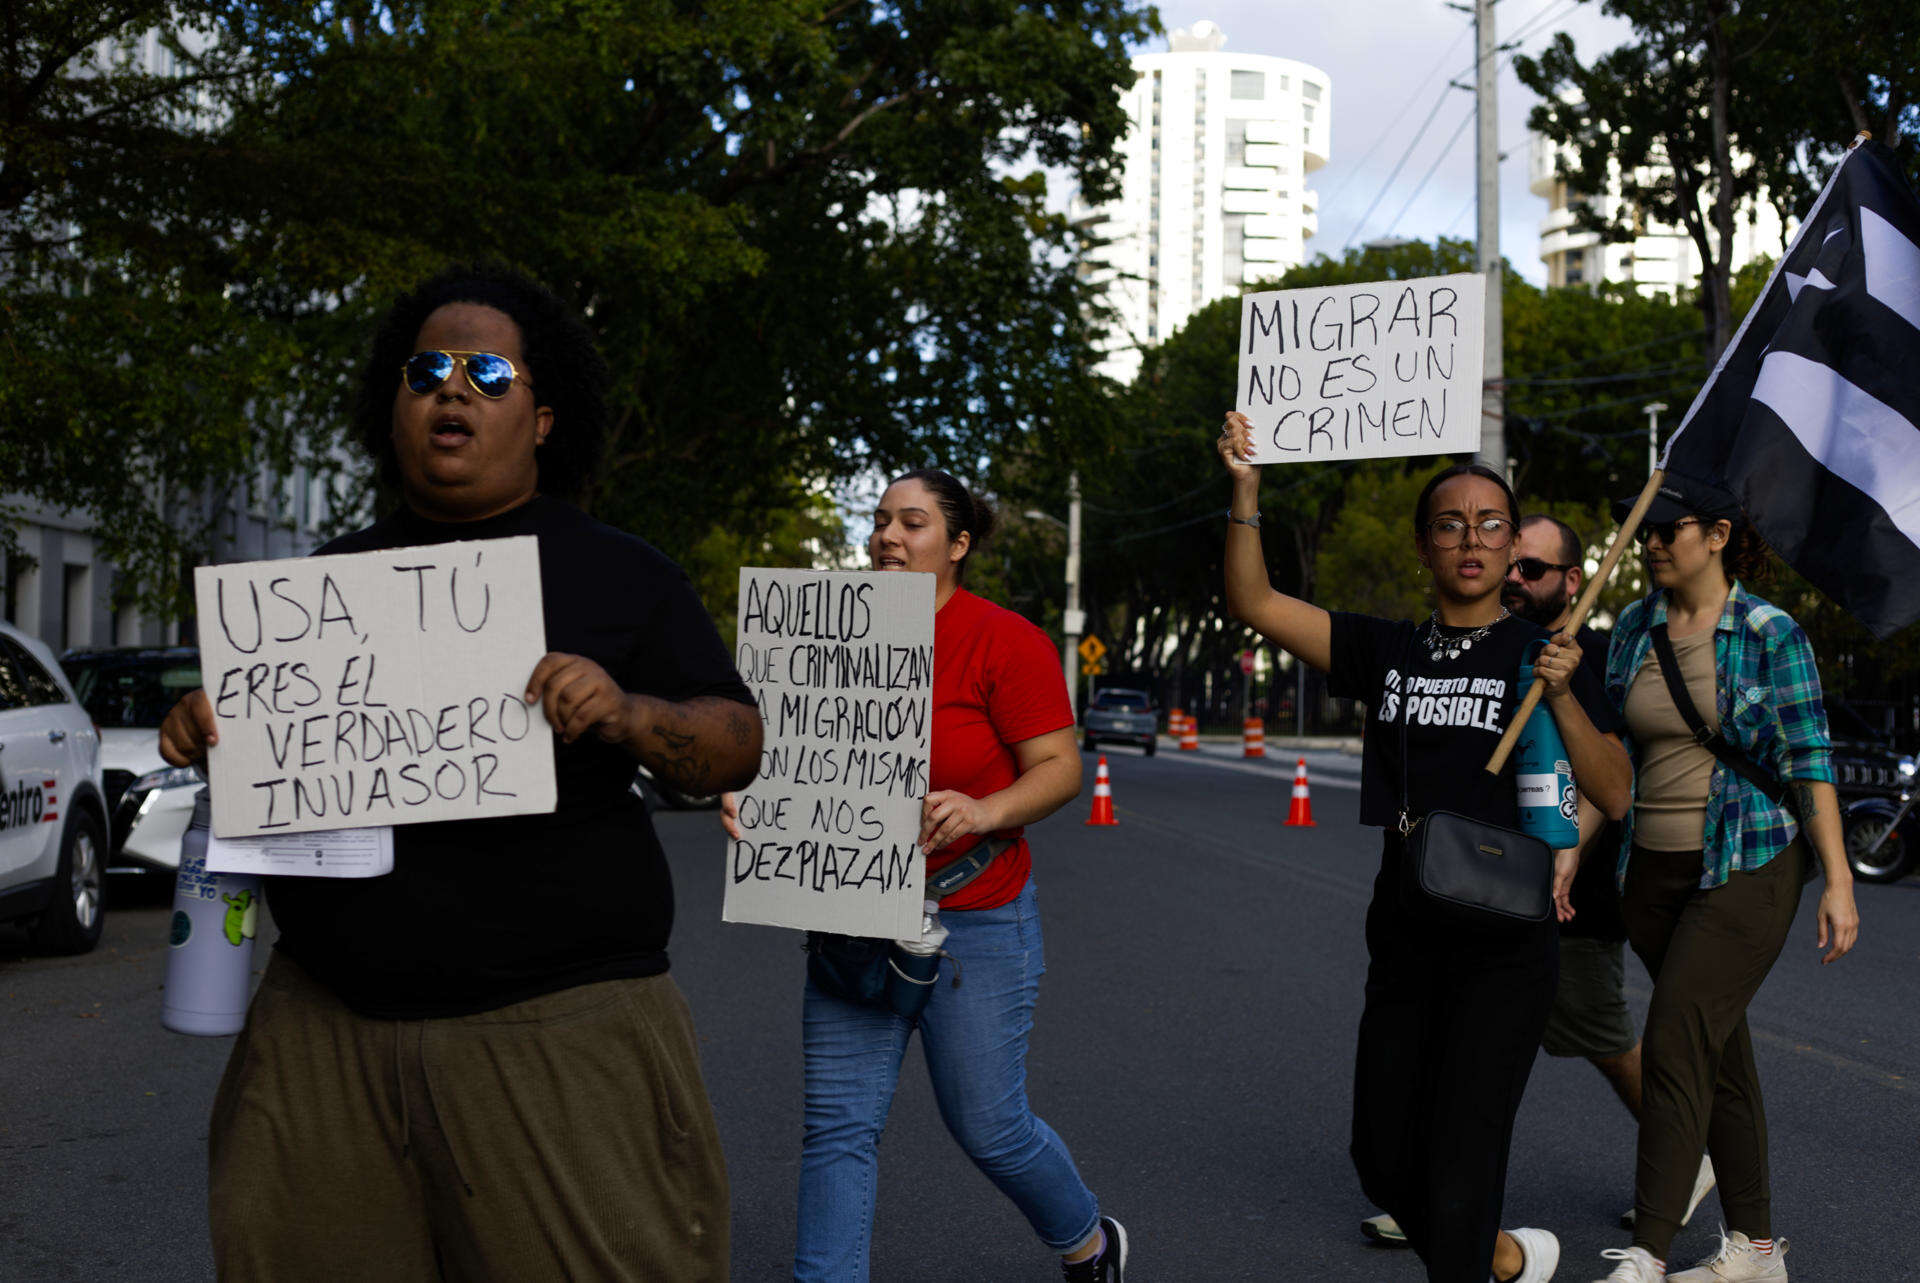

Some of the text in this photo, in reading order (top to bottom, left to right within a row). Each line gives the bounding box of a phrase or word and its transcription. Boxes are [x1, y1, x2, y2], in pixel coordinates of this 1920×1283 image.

[1249, 286, 1457, 355] MIGRAR
[1248, 343, 1454, 405] NO ES UN
[1273, 388, 1447, 454] CRIMEN
[217, 551, 490, 654] USA, TÚ
[743, 577, 874, 643] AQUELLOS
[216, 653, 387, 719] ERES EL
[737, 643, 933, 692] QUE CRIMINALIZAN
[1413, 676, 1469, 695] PUERTO
[1469, 677, 1506, 699] RICO
[265, 692, 530, 771] VERDADERO
[757, 688, 926, 748] A MIGRACIÓN,
[1405, 695, 1504, 735] POSIBLE.
[252, 753, 518, 830] INVASOR
[759, 745, 927, 800] ON LOS MISMOS
[739, 795, 884, 841] QUE NOS
[734, 839, 915, 893] DEZPLAZAN.
